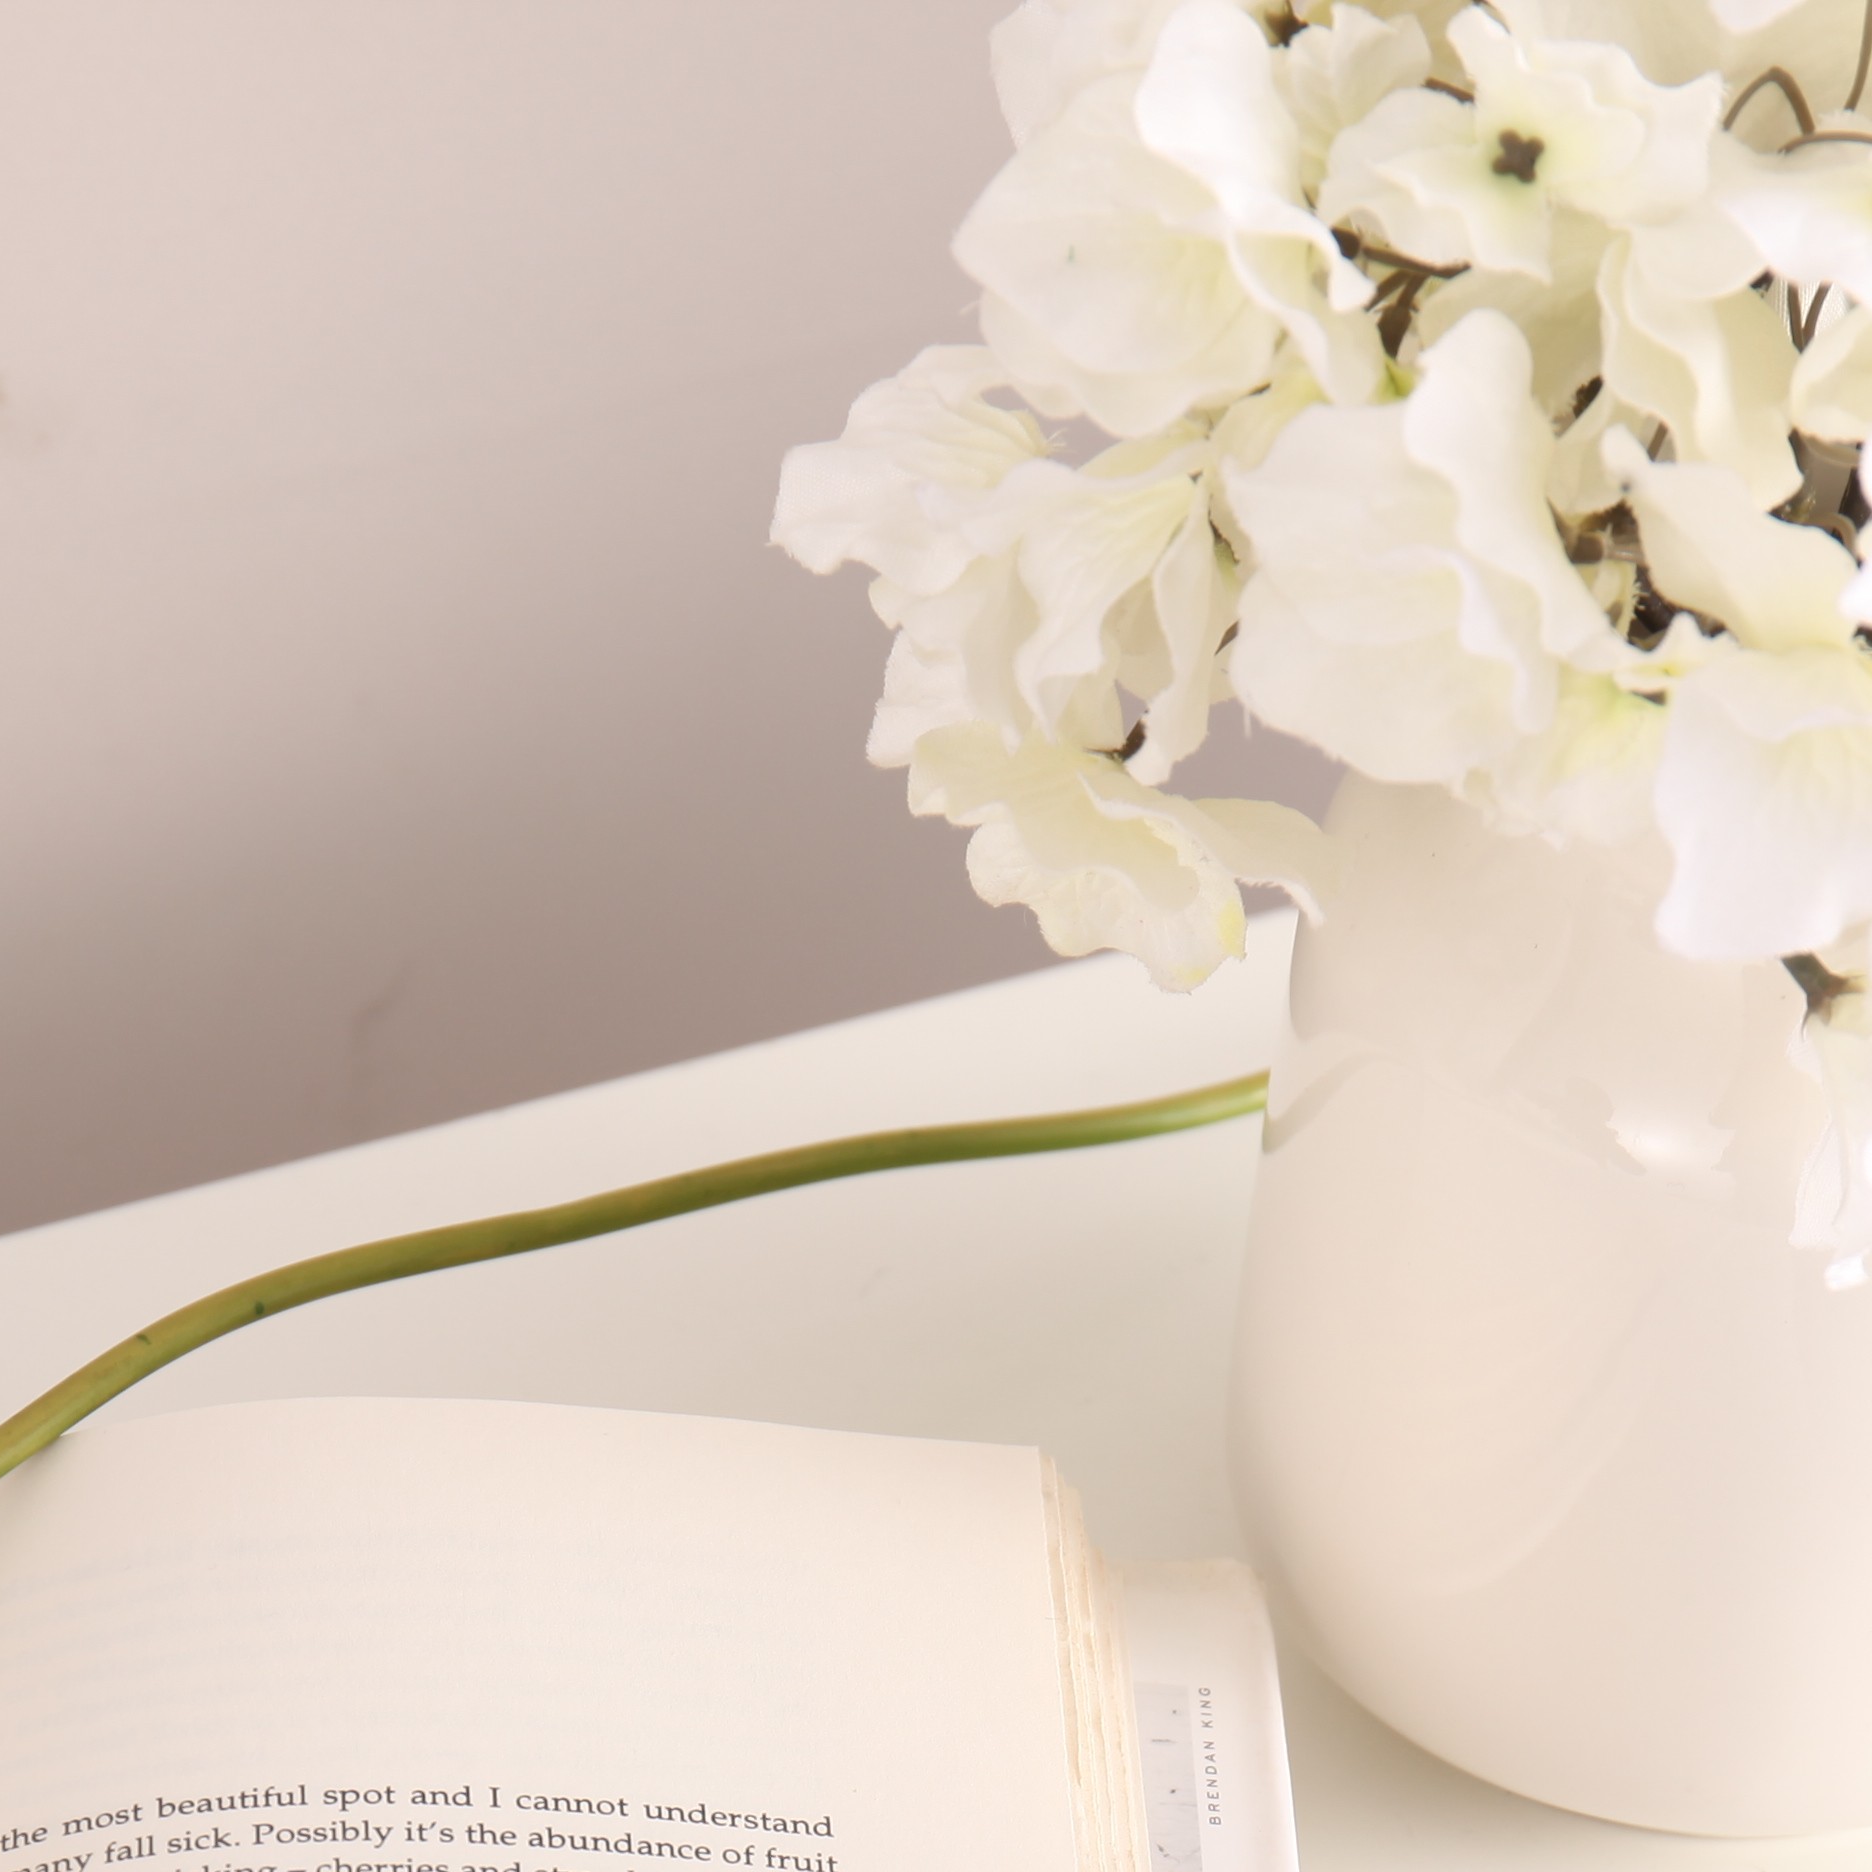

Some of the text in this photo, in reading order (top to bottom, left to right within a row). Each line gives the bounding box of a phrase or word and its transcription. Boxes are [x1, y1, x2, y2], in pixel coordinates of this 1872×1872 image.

[1198, 1687, 1222, 1826] BRENDAN KING
[0, 1826, 49, 1853] the
[61, 1803, 143, 1837] most
[155, 1783, 309, 1819] beautiful
[322, 1785, 396, 1812] spot
[410, 1785, 474, 1807] and
[489, 1786, 501, 1809] I
[515, 1794, 629, 1817] cannot
[643, 1802, 835, 1838] understand
[104, 1834, 157, 1864] fall
[167, 1826, 240, 1854] sick.
[251, 1819, 394, 1849] Possibly
[464, 1822, 518, 1847] the
[527, 1826, 712, 1862] abundance
[721, 1844, 756, 1866] of
